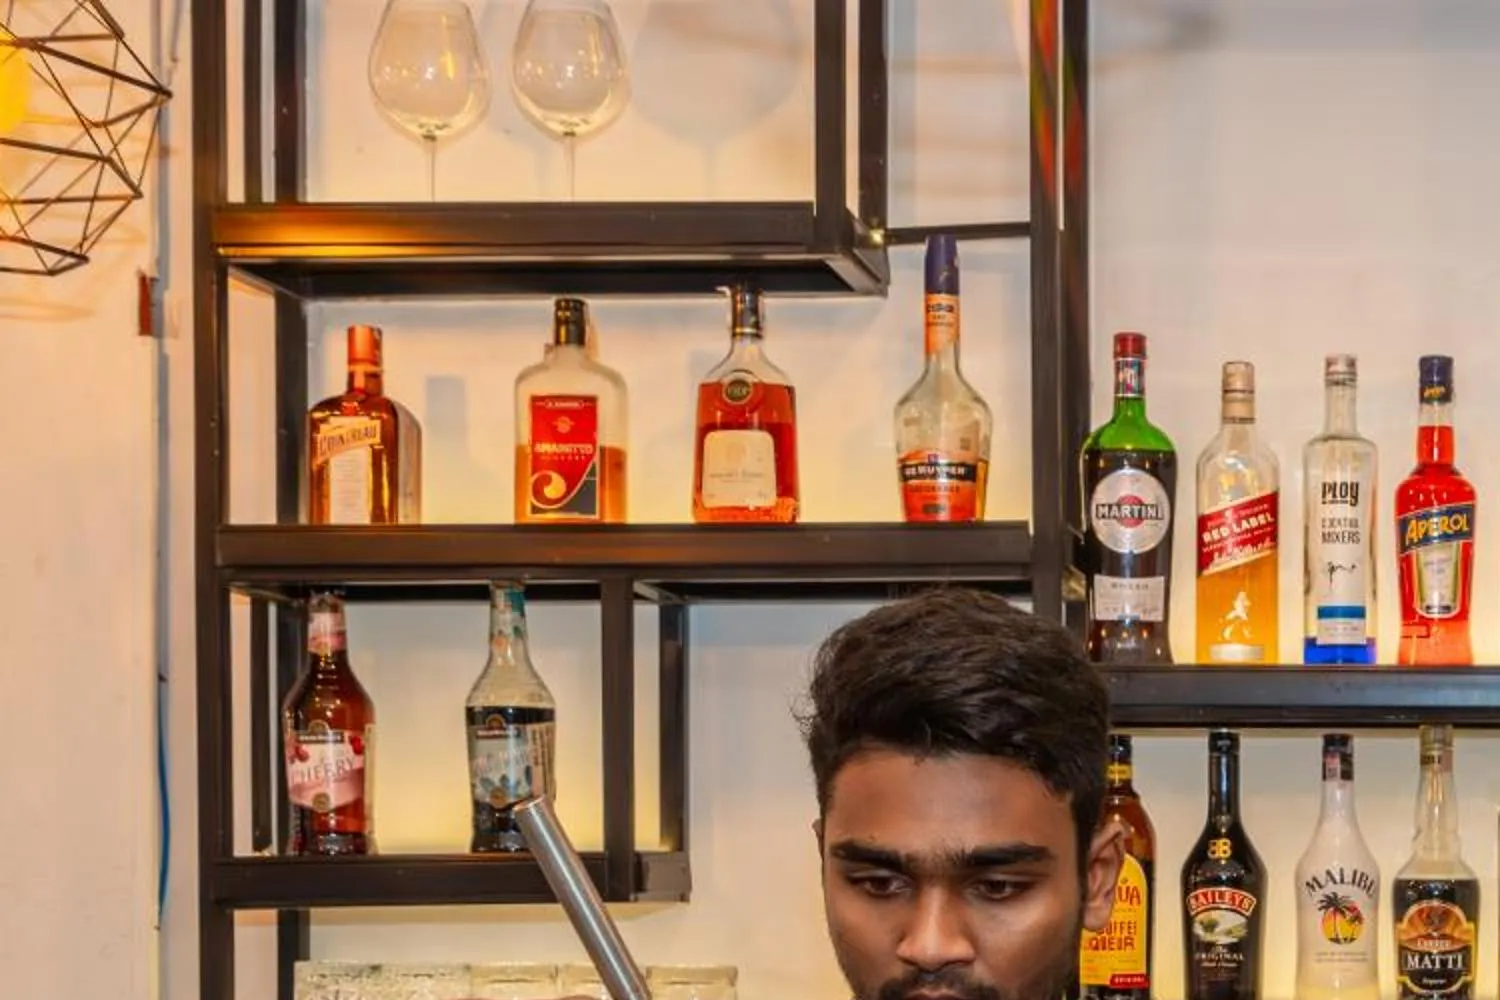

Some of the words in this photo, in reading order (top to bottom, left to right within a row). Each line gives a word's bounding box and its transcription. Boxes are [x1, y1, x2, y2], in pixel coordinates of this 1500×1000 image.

[1321, 530, 1361, 545] MIXERS
[1405, 512, 1470, 546] APEROL
[1189, 889, 1254, 912] BAILEYS
[1406, 951, 1464, 969] MATTI
